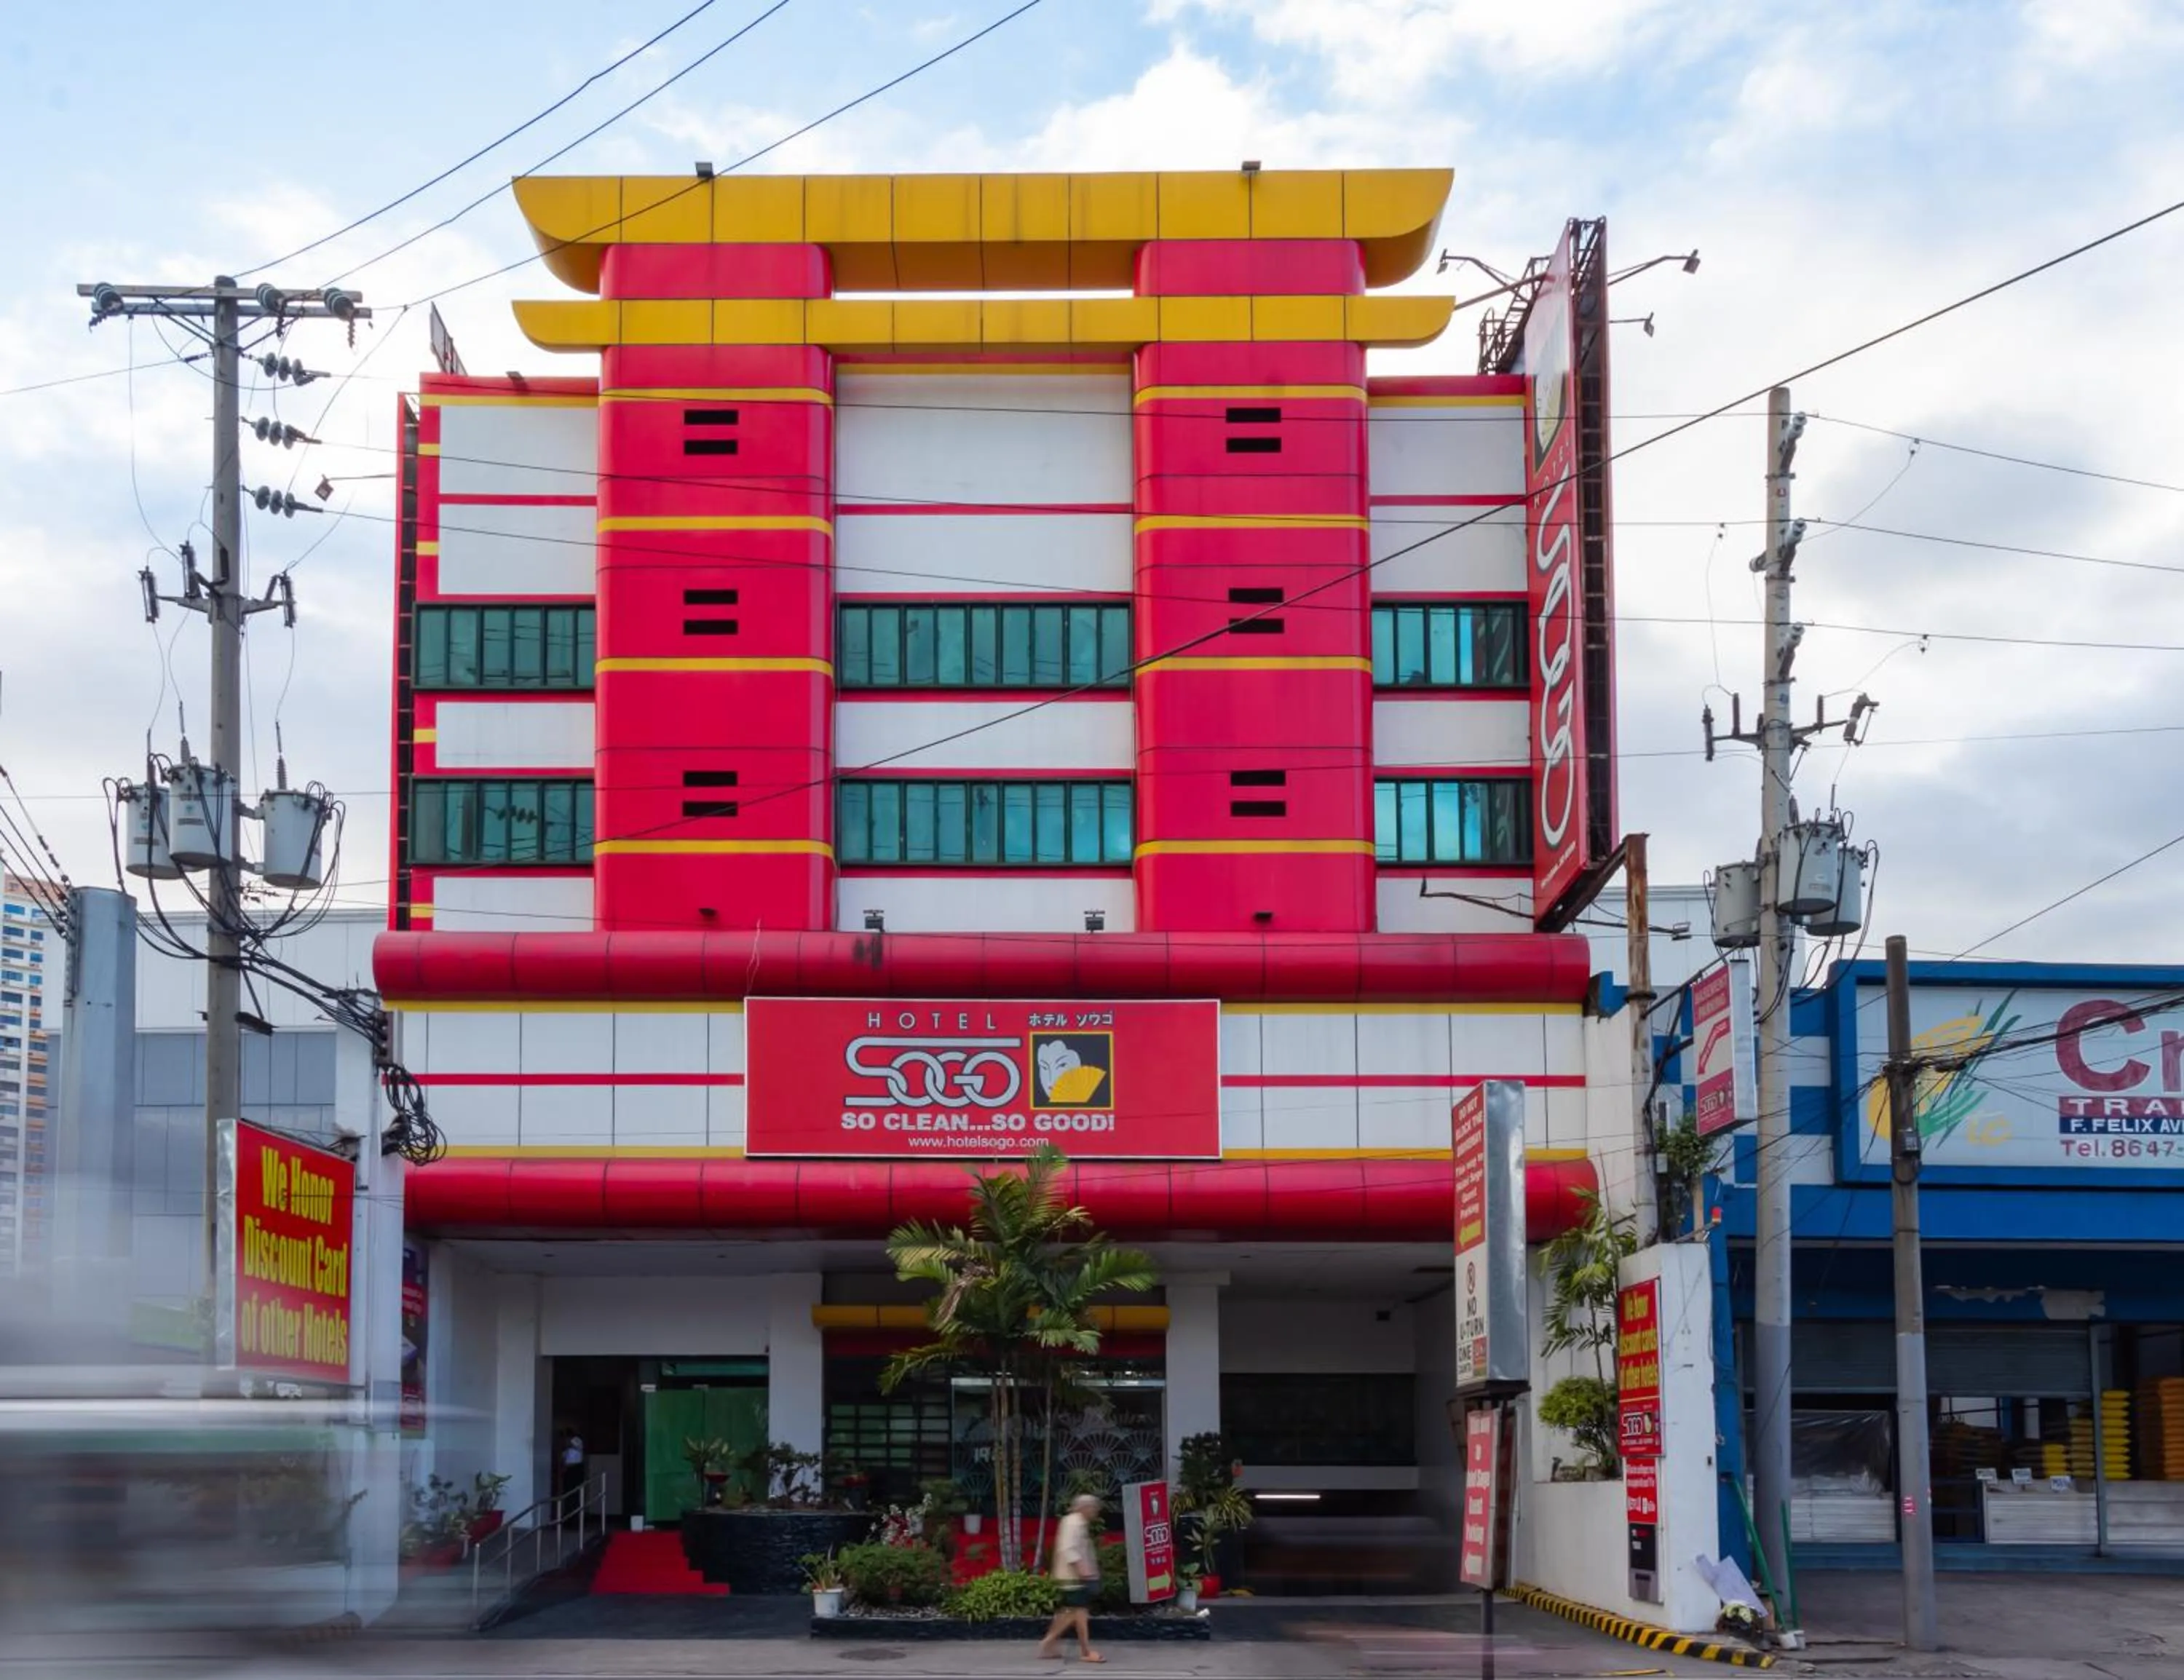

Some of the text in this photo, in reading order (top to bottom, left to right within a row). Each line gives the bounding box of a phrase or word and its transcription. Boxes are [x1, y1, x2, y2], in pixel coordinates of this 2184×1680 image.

[1537, 461, 1574, 847] SOGO
[869, 1013, 996, 1029] HOTEL
[1029, 1013, 1068, 1027] ホテル
[844, 1036, 1021, 1107] SOGO
[2068, 1098, 2184, 1116] TRA
[841, 1112, 876, 1130] SO
[1034, 1114, 1115, 1132] GOOD!
[2070, 1118, 2088, 1133] F.
[2092, 1118, 2153, 1133] FELIX
[908, 1135, 1049, 1150] www.hotelsogo.com
[261, 1145, 335, 1225] We Honor
[243, 1214, 348, 1297] Discount Card
[1467, 1295, 1477, 1318] NO
[241, 1291, 348, 1366] of other Hotels
[1460, 1314, 1484, 1340] U-TURN
